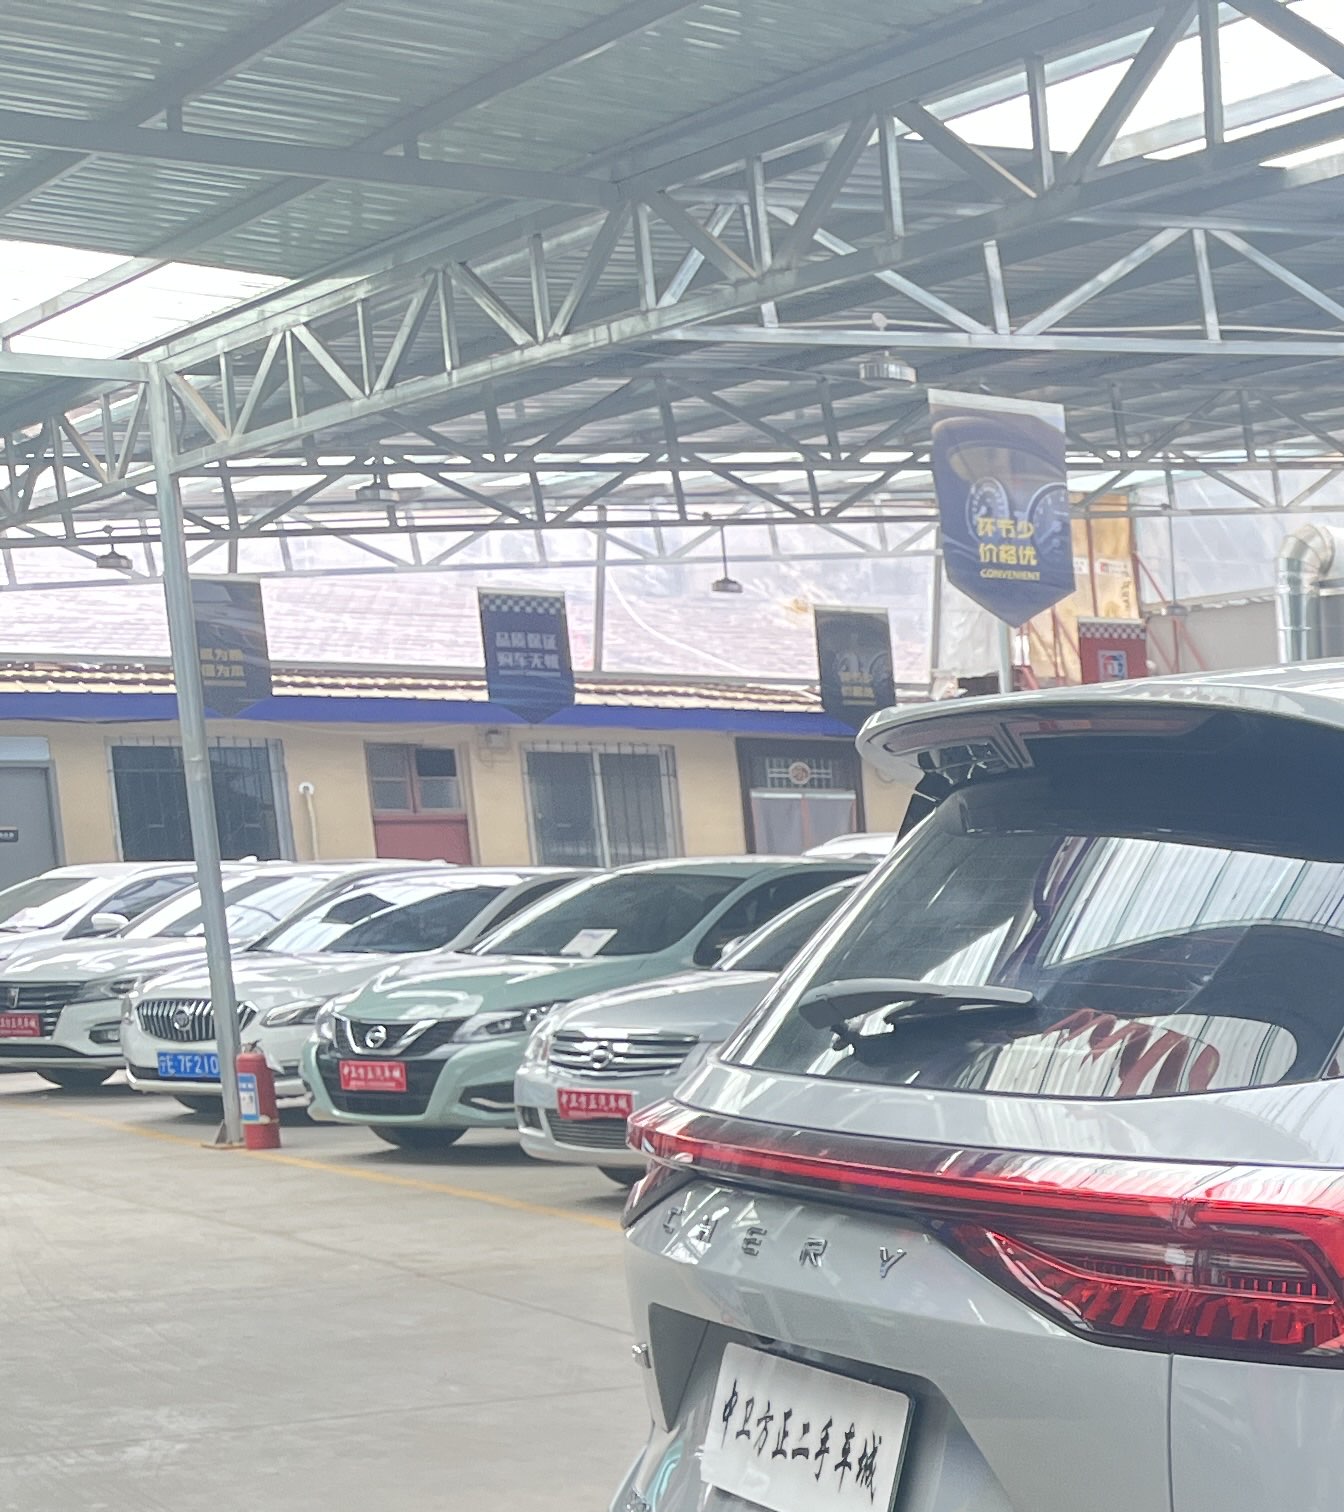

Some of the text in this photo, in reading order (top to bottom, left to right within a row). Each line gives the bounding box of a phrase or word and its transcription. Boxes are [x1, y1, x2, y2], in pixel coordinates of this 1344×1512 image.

[976, 516, 1035, 539] 环节少
[979, 543, 1038, 566] 价格优
[721, 1378, 882, 1504] 中卫方正二手车城
